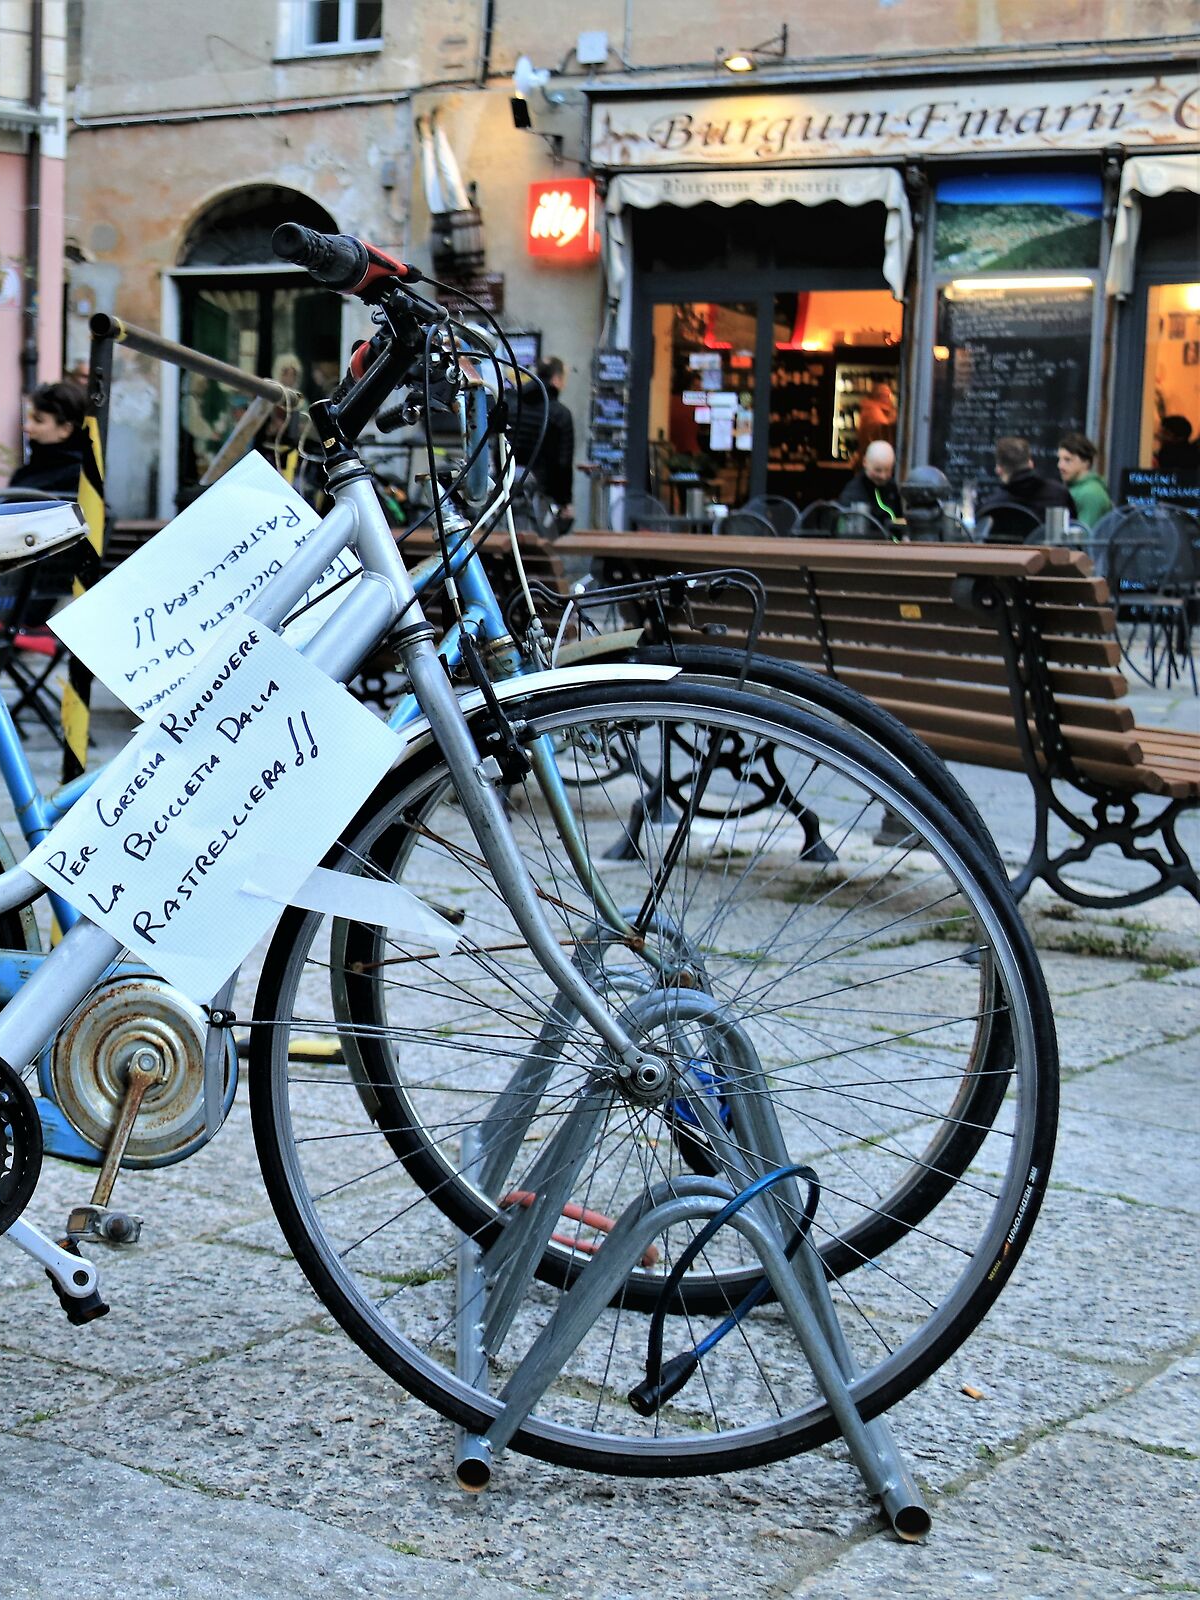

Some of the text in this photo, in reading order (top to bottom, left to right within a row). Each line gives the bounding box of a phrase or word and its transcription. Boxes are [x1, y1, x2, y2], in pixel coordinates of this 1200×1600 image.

[647, 110, 888, 157] Burgum
[904, 87, 1134, 141] Finarii
[530, 191, 588, 247] illy
[44, 630, 260, 885] PER CORTESIA RIMUOVERE
[88, 882, 126, 914] LA
[123, 753, 220, 862] BICICLETTA
